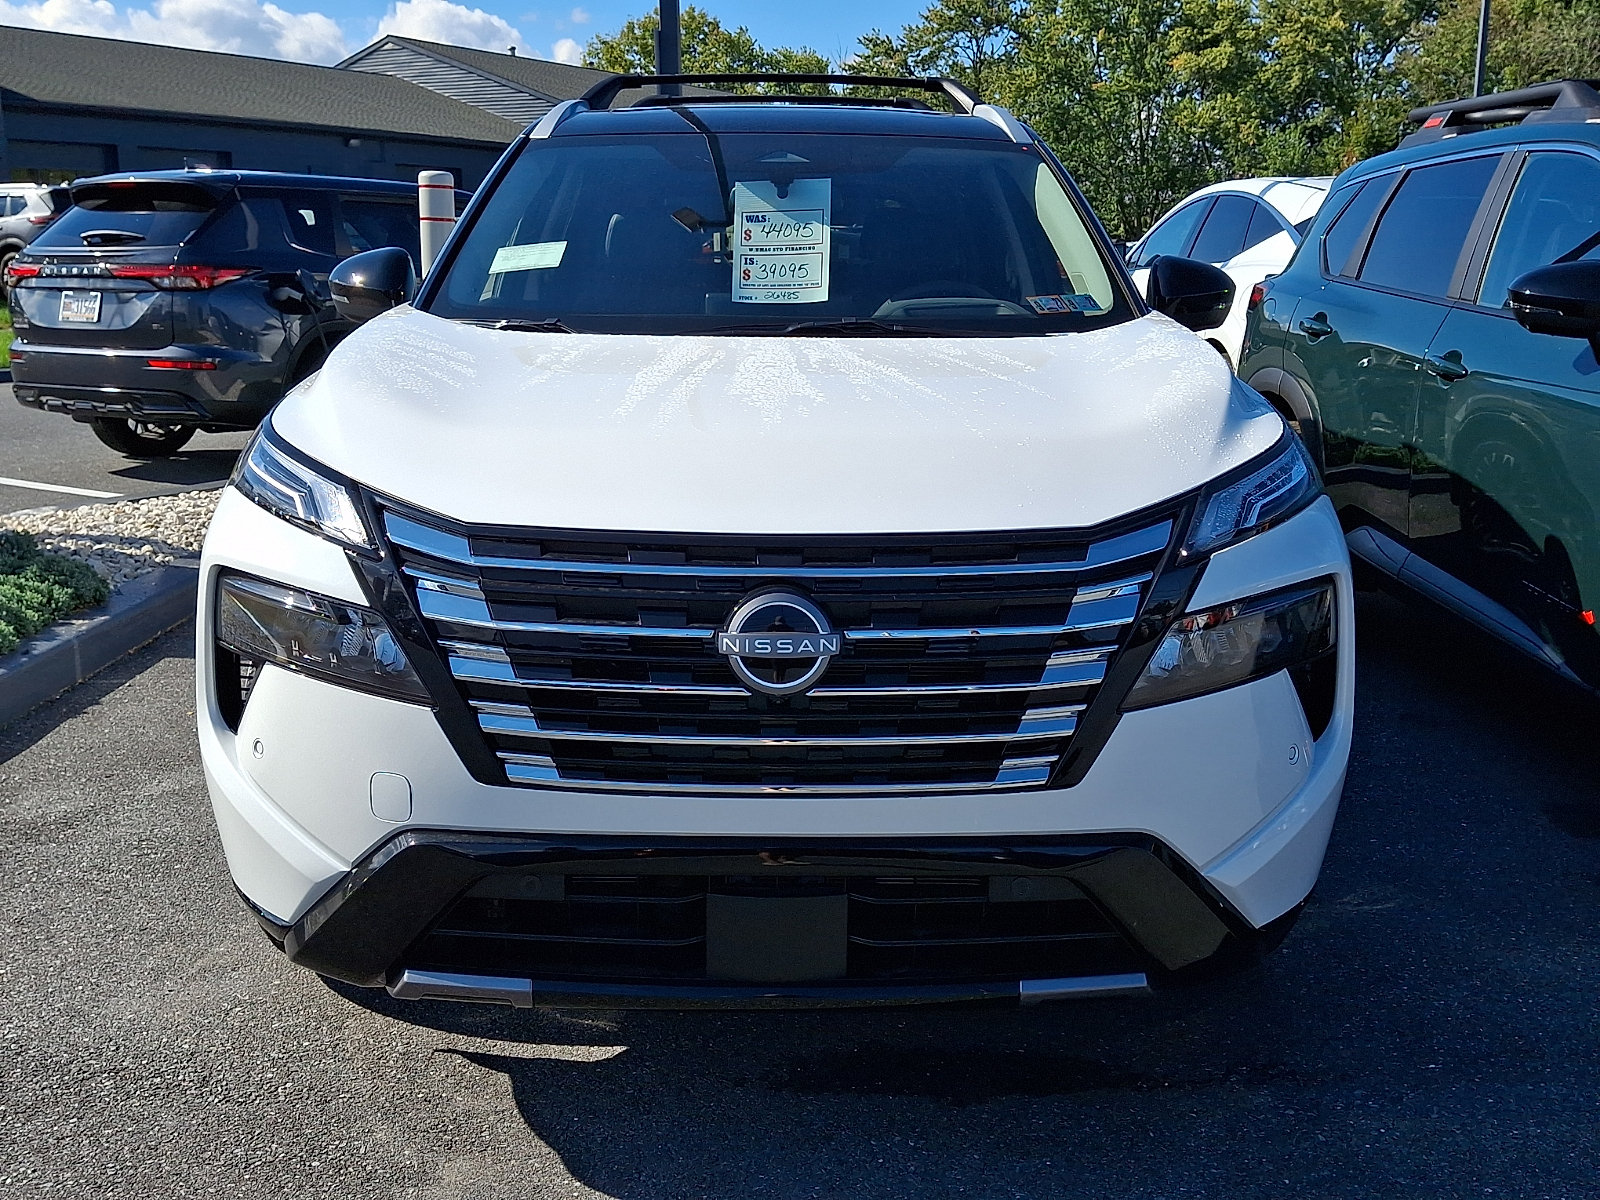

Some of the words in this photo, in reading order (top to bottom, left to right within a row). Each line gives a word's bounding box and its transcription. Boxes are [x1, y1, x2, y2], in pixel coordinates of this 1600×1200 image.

[745, 215, 770, 224] WAS:
[760, 222, 814, 239] 44095
[743, 257, 759, 265] IS:
[755, 263, 810, 280] 39095
[763, 290, 800, 300] 26485
[722, 637, 837, 653] NISSAN
